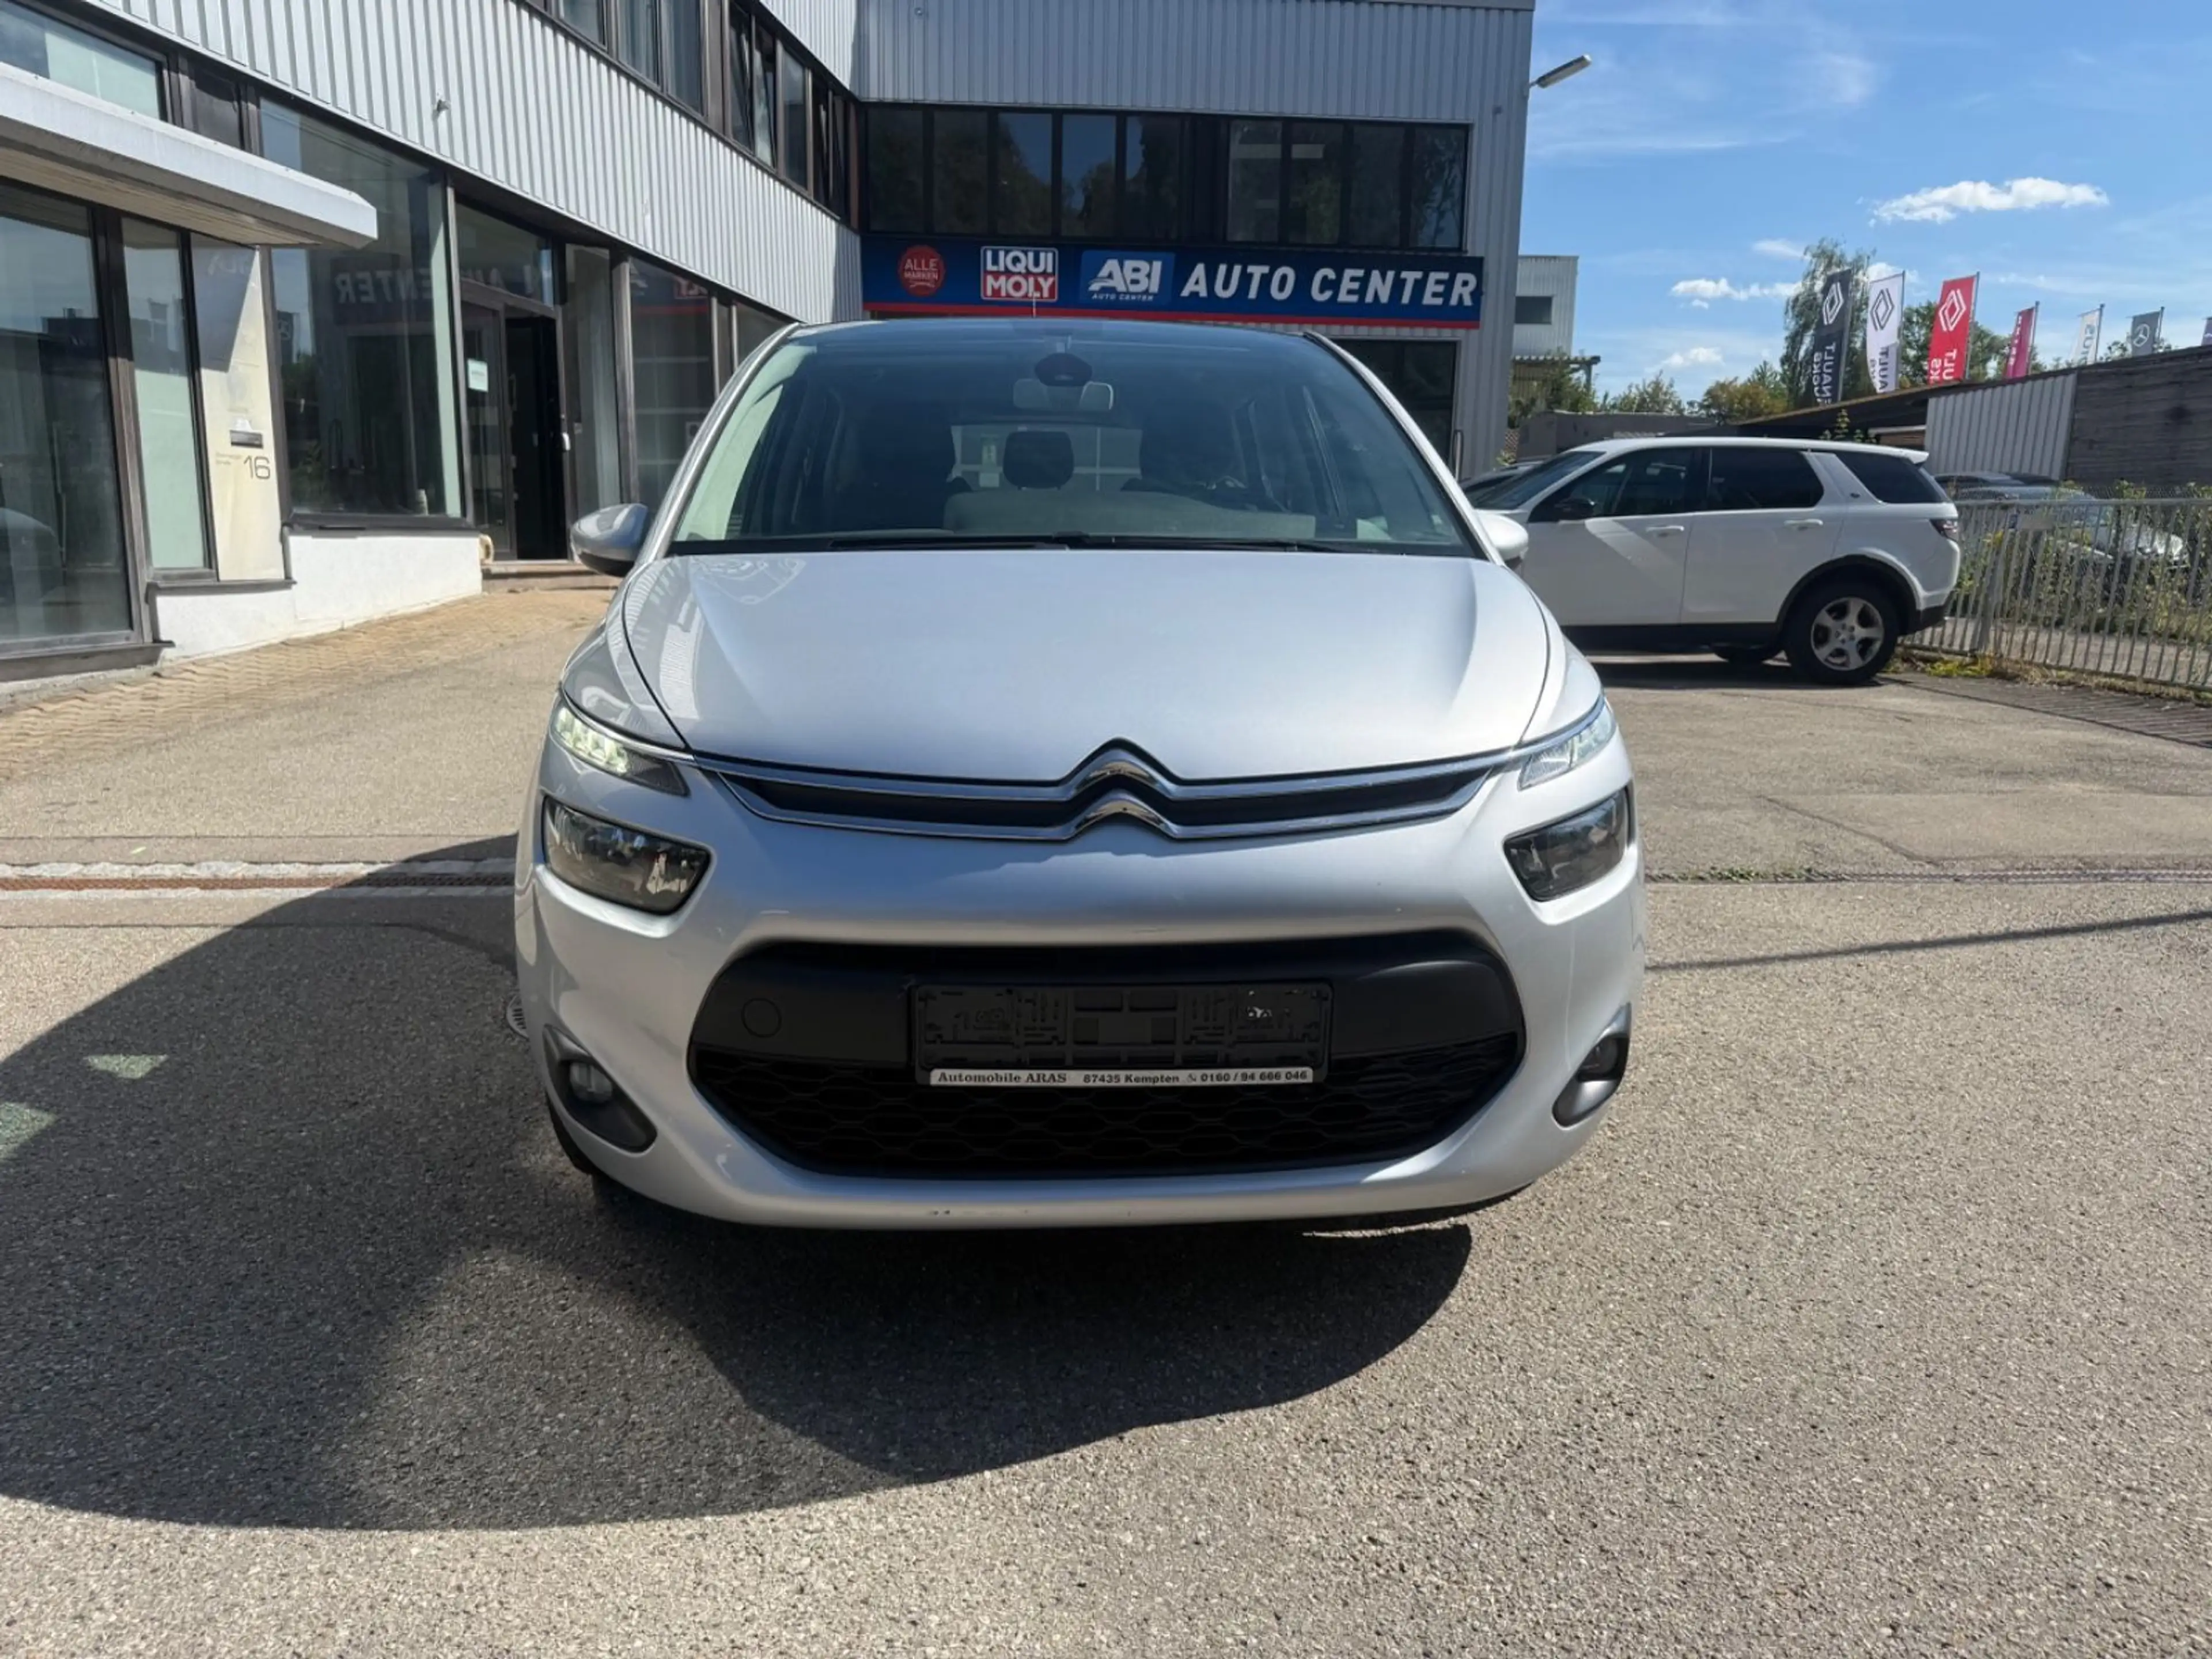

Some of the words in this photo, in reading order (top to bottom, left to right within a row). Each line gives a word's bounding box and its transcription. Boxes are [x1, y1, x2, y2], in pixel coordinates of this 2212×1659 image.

[904, 258, 938, 270] ALLE
[986, 249, 1053, 273] LIQUI
[904, 270, 938, 281] MARKEN
[986, 275, 1055, 297] MOLY
[1088, 258, 1162, 293] ABI
[1180, 263, 1296, 301] AUTO
[1310, 268, 1477, 306] CENTER
[244, 455, 271, 479] 16
[938, 1071, 1021, 1083] Automobile
[1025, 1072, 1067, 1084] ARAS
[1083, 1074, 1121, 1084] 87435
[1123, 1074, 1180, 1085] Kempten
